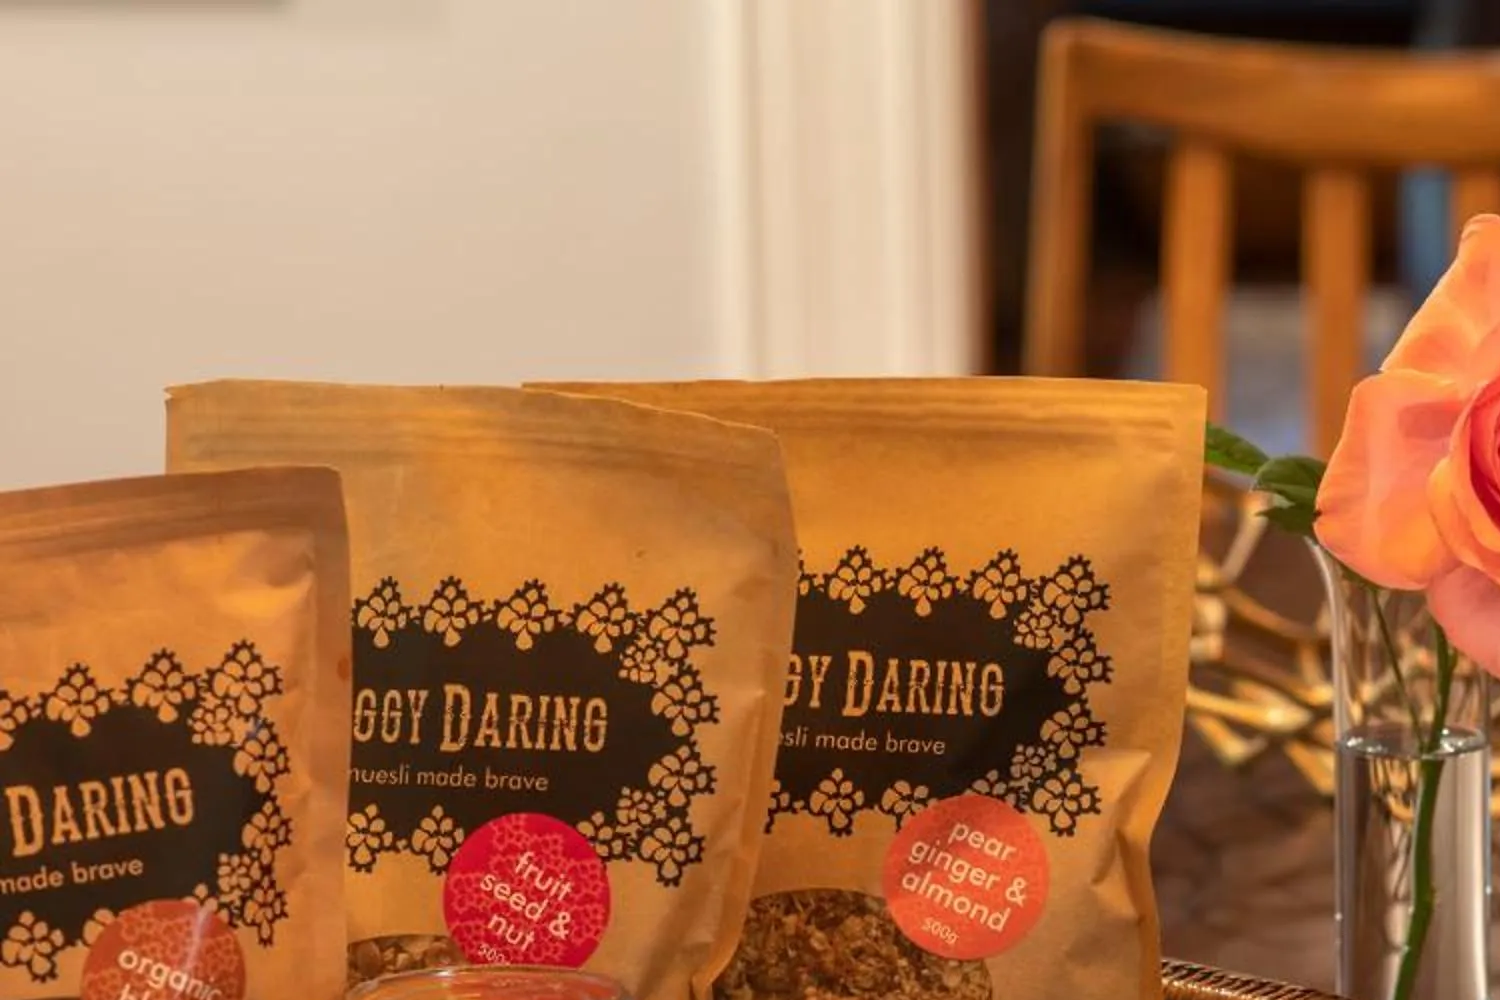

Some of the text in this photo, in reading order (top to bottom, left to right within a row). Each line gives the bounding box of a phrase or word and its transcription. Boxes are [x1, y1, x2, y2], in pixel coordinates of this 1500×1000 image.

[842, 650, 1005, 716] DARING
[440, 683, 608, 752] DARING
[780, 726, 946, 755] sli made brave
[417, 767, 476, 788] made
[485, 772, 549, 791] brave
[5, 767, 194, 858] DARING
[947, 821, 1017, 864] pear
[72, 858, 144, 884] brave
[515, 851, 572, 901] fruit
[908, 840, 1028, 909] ginger &
[480, 874, 571, 940] seed &
[901, 871, 1013, 933] almond
[488, 914, 535, 952] nut
[920, 916, 960, 946] 500g
[478, 943, 511, 966] 500
